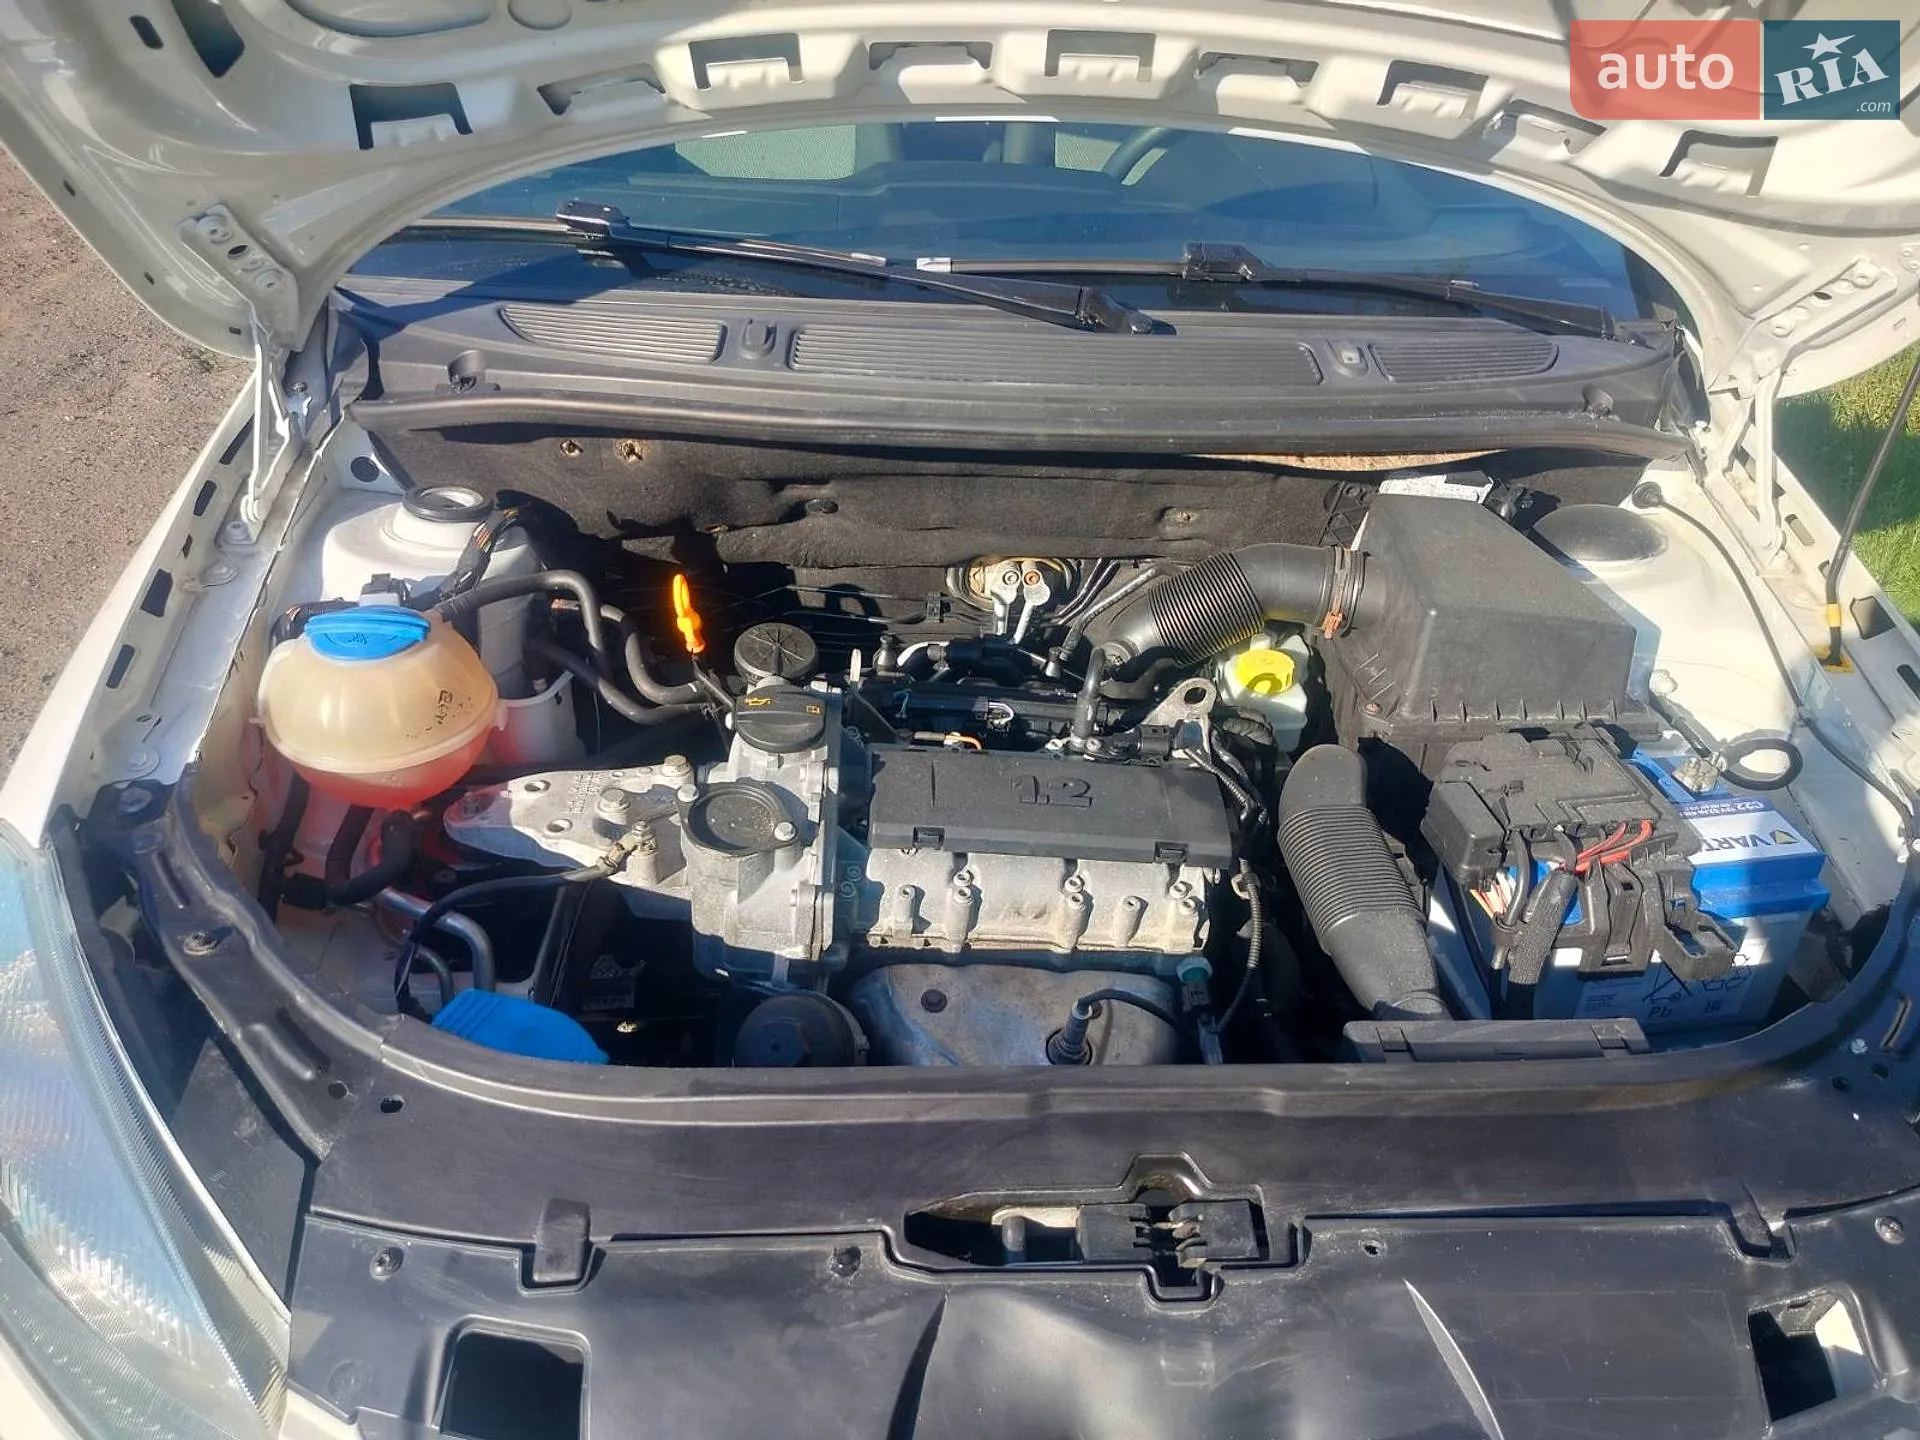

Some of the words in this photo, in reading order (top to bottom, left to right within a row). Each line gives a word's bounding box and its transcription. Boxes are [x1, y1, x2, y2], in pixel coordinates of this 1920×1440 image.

[1010, 775, 1092, 807] 1.2
[1700, 833, 1772, 851] VART
[1649, 1006, 1672, 1017] Pb
